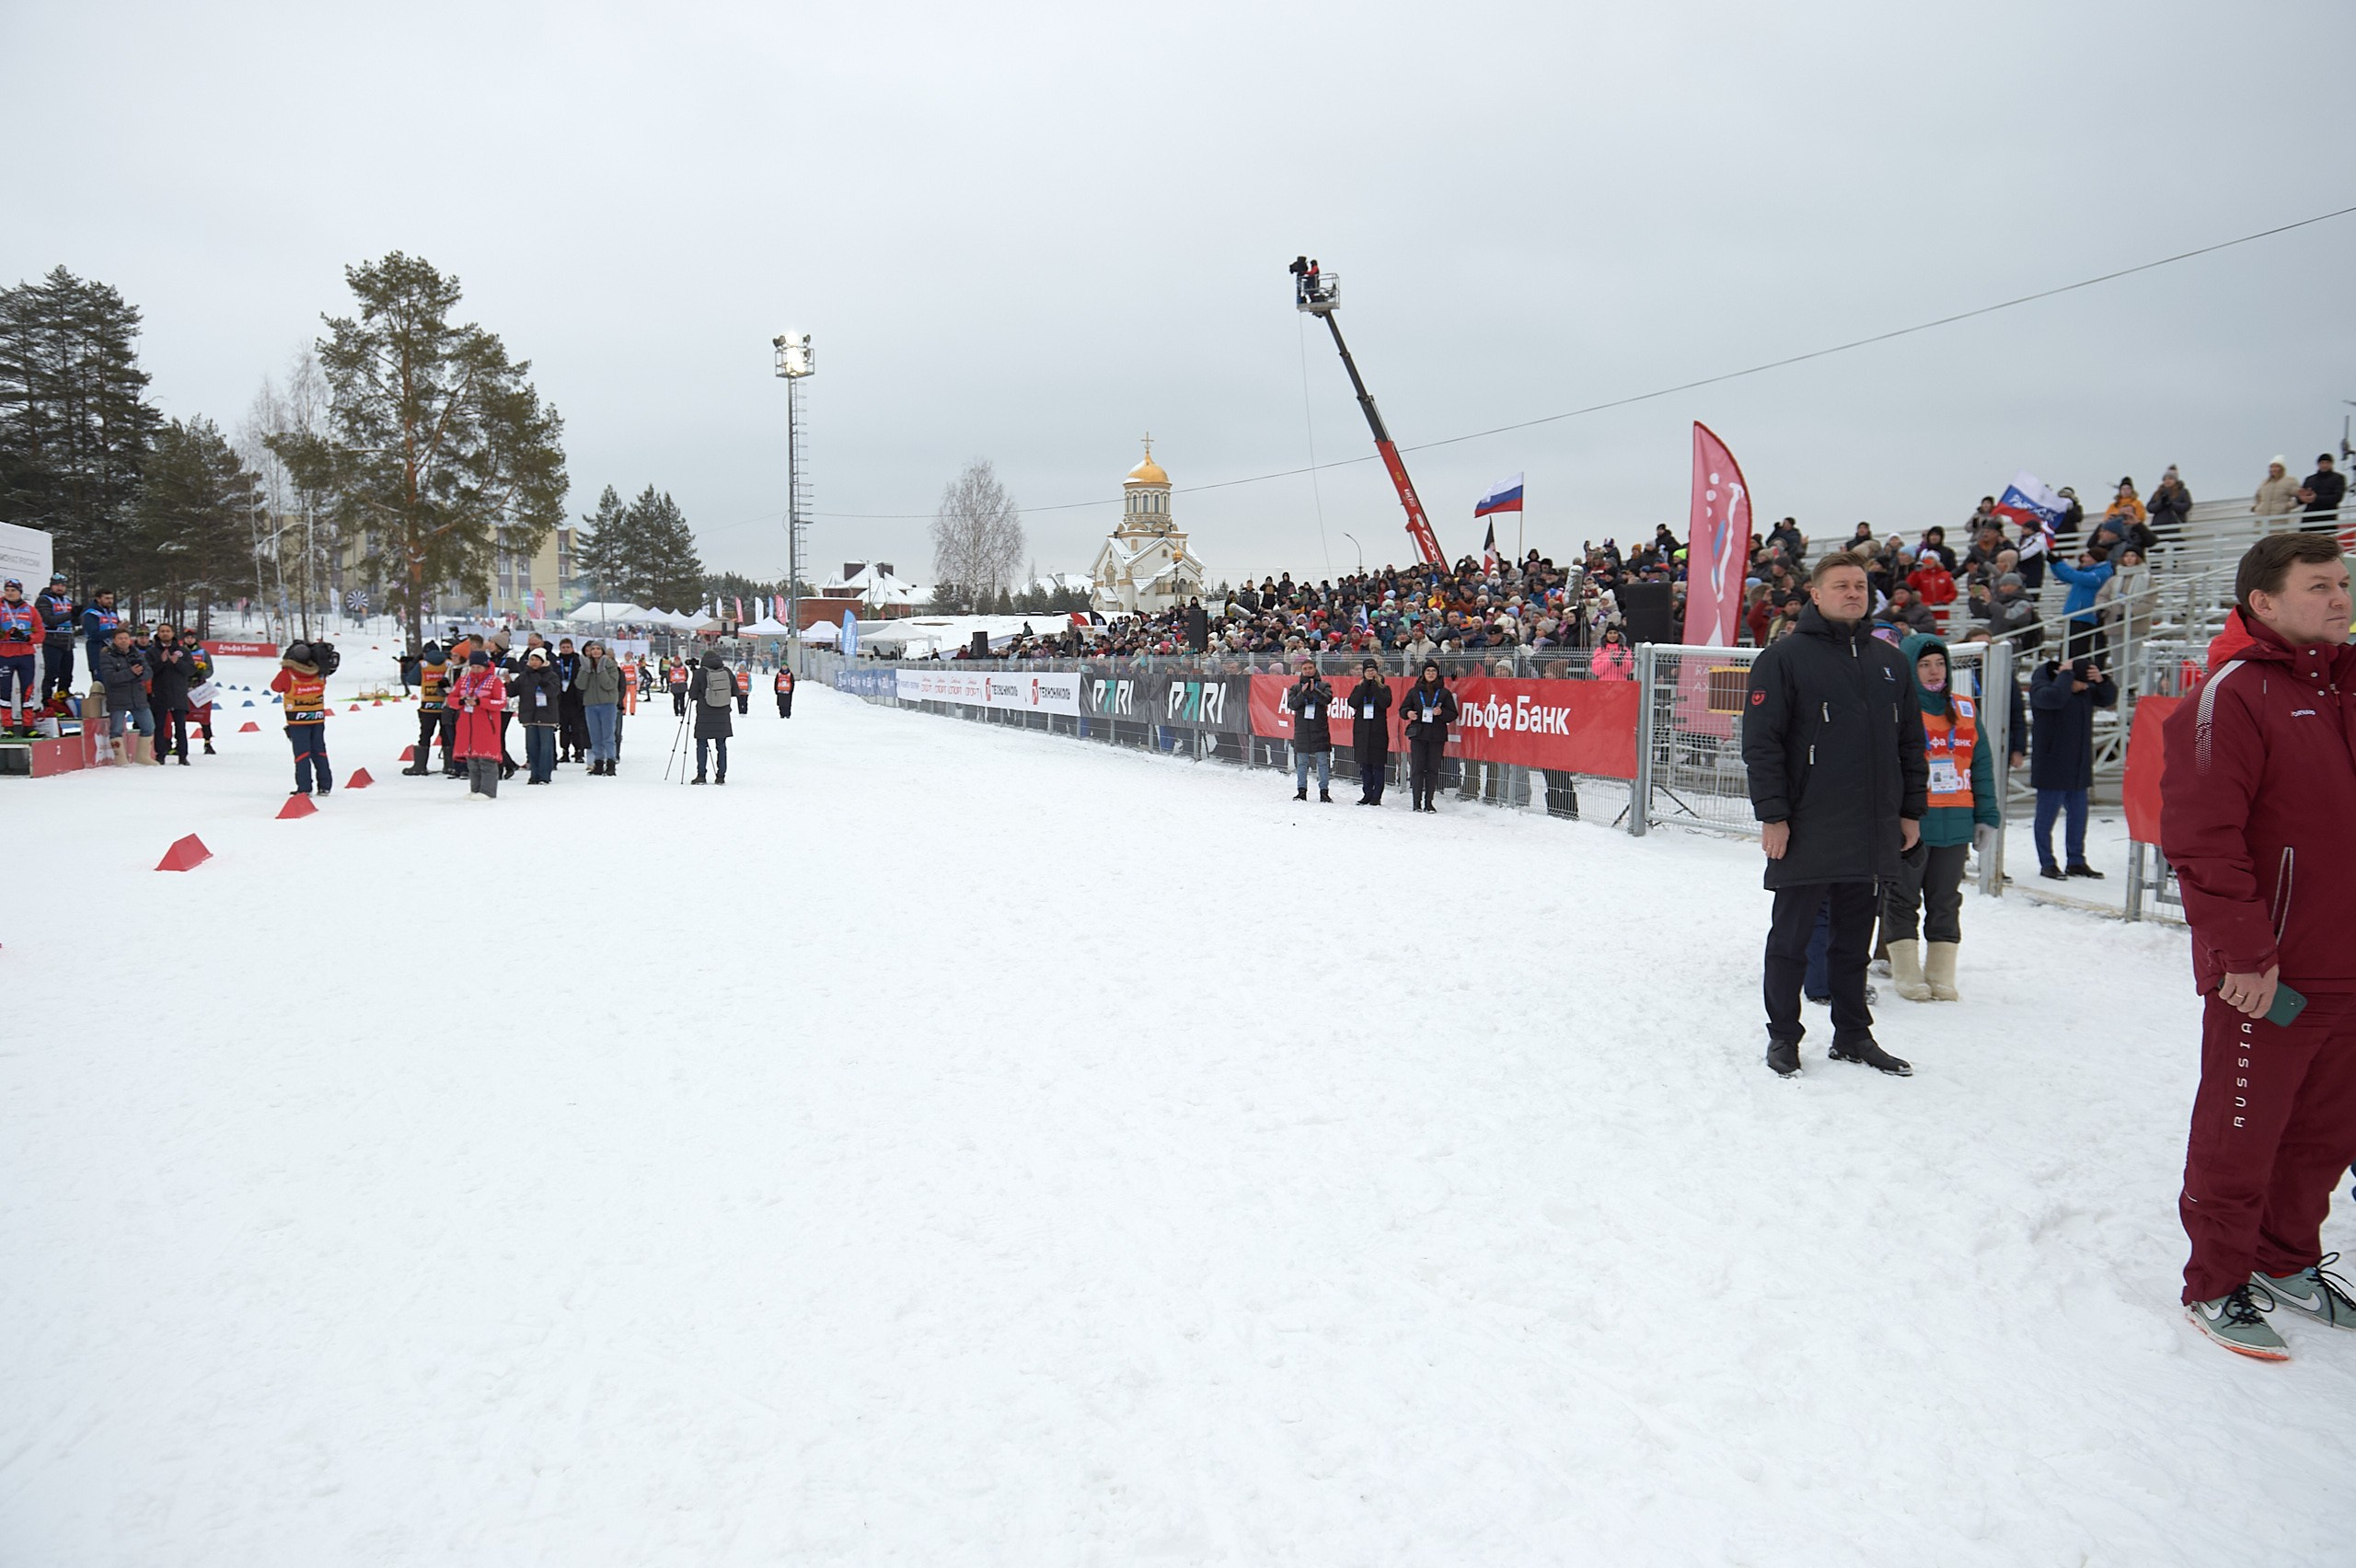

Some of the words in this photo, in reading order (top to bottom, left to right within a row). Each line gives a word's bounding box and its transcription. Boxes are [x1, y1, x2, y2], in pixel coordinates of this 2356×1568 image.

[1092, 679, 1134, 715] PARI
[1168, 681, 1227, 724] PARI
[1515, 695, 1571, 735] Банк
[1952, 738, 1971, 747] анк
[2233, 1022, 2253, 1128] RUSSIA
